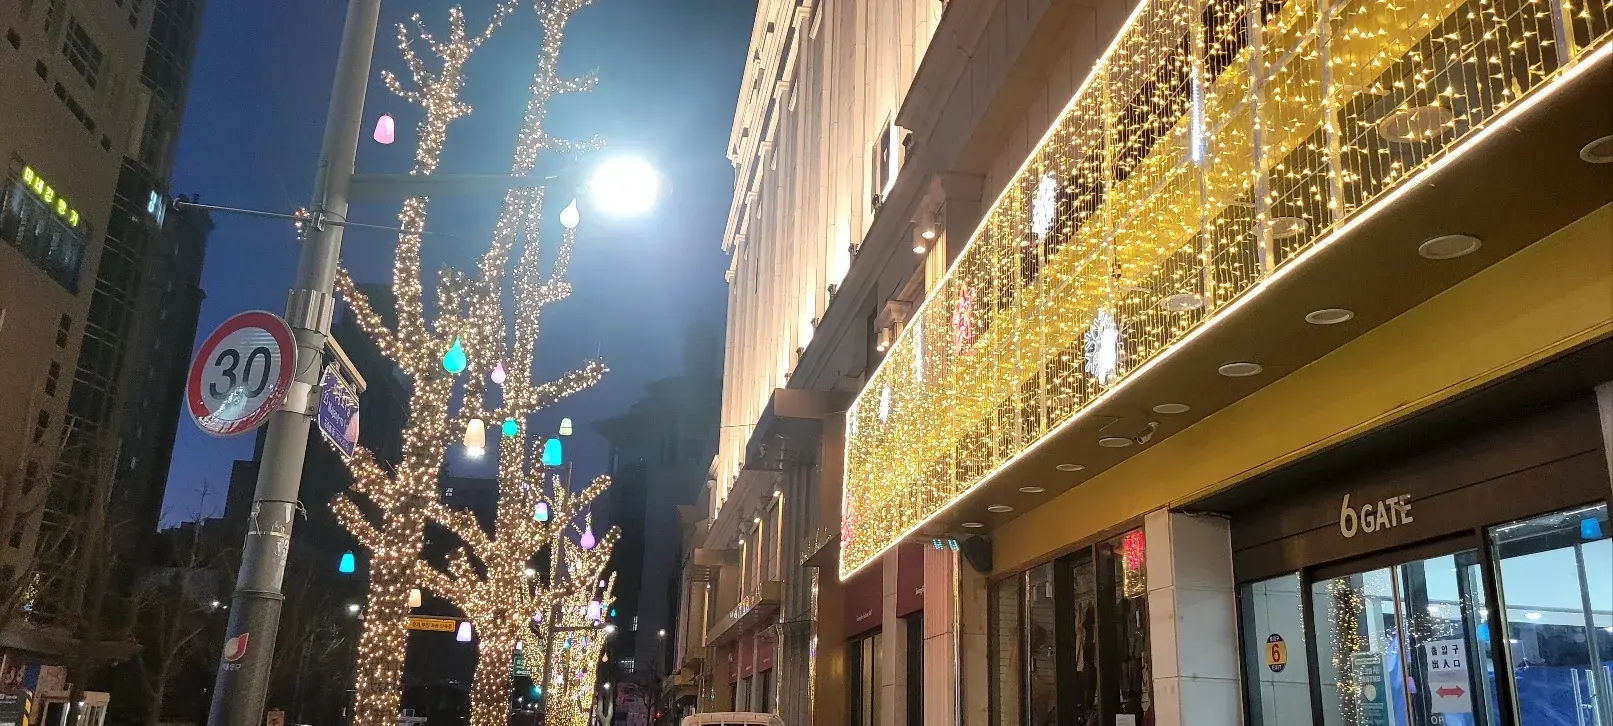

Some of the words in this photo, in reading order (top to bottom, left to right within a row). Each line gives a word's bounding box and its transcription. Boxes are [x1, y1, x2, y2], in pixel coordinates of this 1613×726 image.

[209, 346, 272, 400] 30
[1340, 493, 1358, 538] 6
[1360, 493, 1414, 533] GATE
[1271, 643, 1281, 662] 6
[1431, 645, 1459, 656] 출입구
[1431, 659, 1461, 669] 出入口
